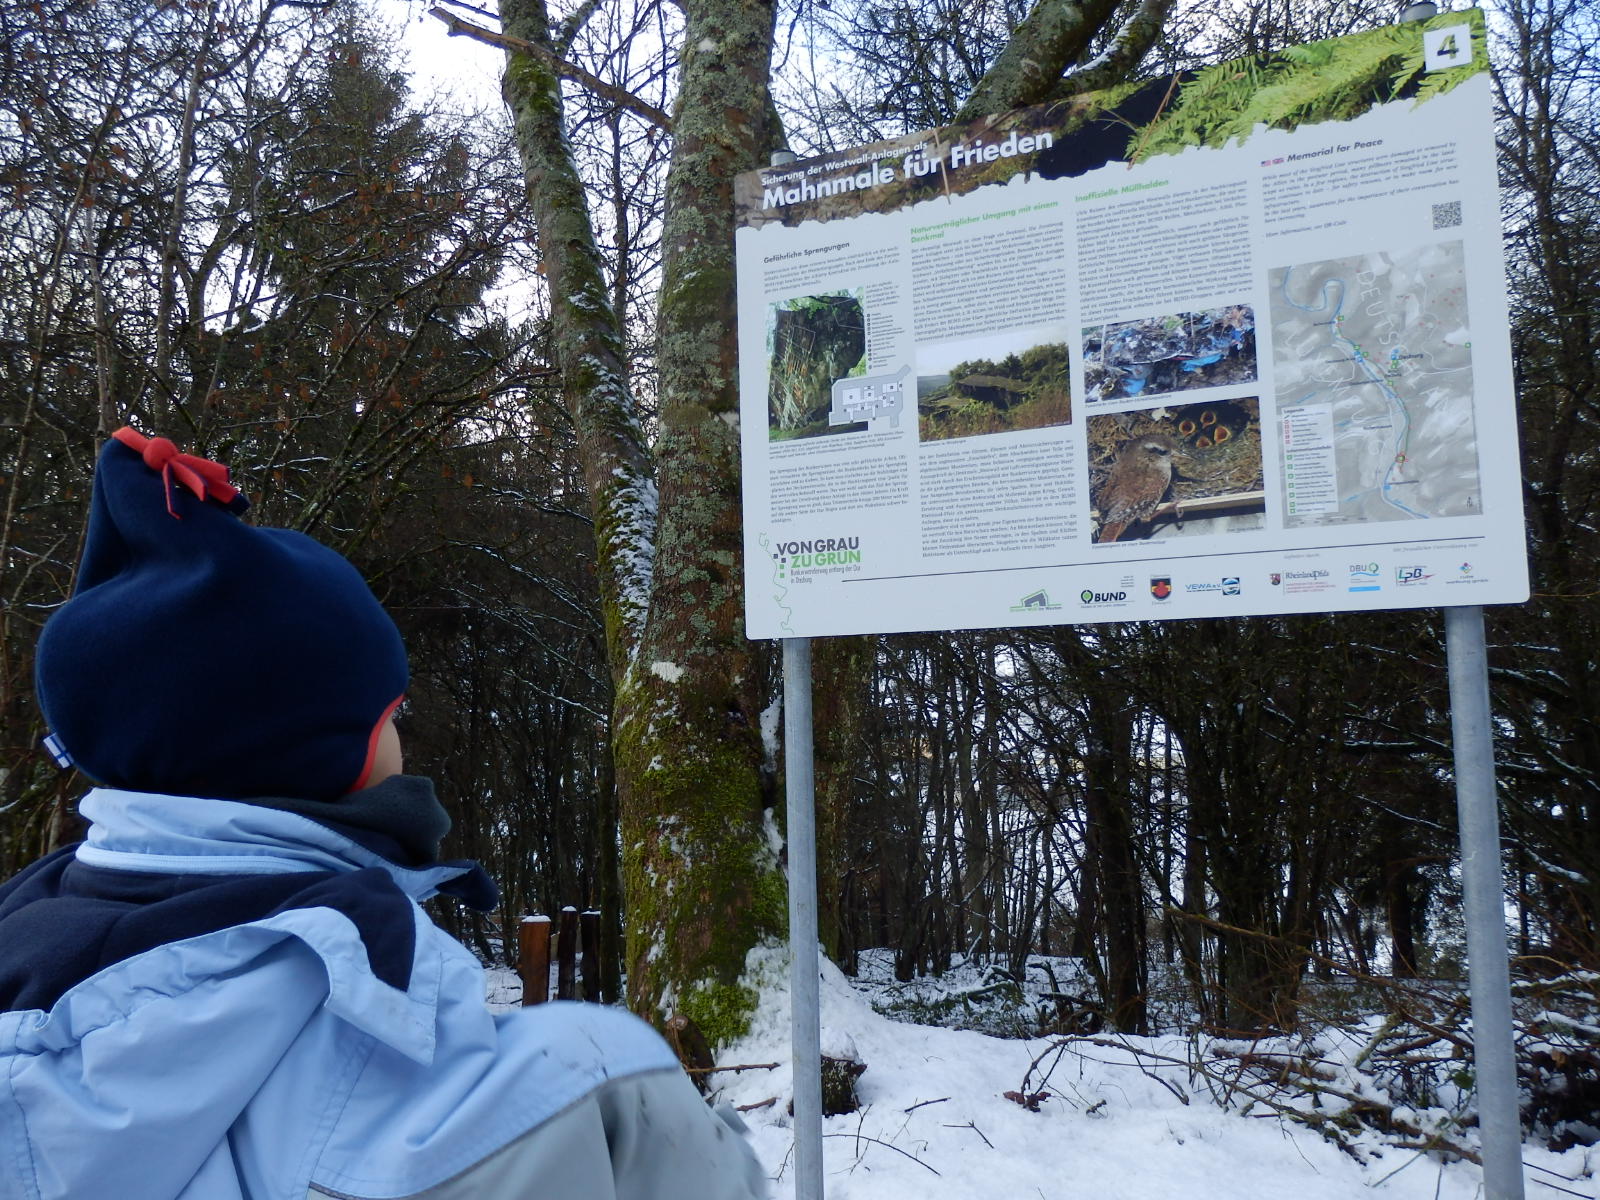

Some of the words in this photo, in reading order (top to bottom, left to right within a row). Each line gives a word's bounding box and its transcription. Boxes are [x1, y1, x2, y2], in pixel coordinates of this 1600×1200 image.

[1437, 33, 1459, 60] 4
[1287, 146, 1334, 163] Memorial
[1336, 144, 1350, 153] for
[1354, 138, 1383, 151] Peace
[761, 169, 805, 186] Sicherung
[807, 165, 823, 176] der
[825, 145, 911, 171] Westwall-Anlagen
[913, 140, 928, 151] als
[762, 162, 895, 210] Mahnmale
[903, 153, 942, 179] für
[951, 131, 1053, 169] Frieden
[1121, 179, 1169, 194] Müllhalden
[911, 215, 981, 235] Naturverträglicher
[982, 208, 1016, 222] Umgang
[1018, 205, 1032, 214] mit
[1033, 200, 1059, 211] einem
[911, 231, 944, 244] Denkmal
[763, 249, 802, 264] Gefährliche
[804, 241, 850, 257] Sprengungen
[776, 540, 812, 556] VON
[814, 536, 859, 553] GRAU
[790, 554, 812, 568] ZU
[1349, 564, 1367, 573] DBU
[1094, 591, 1127, 602] BUND
